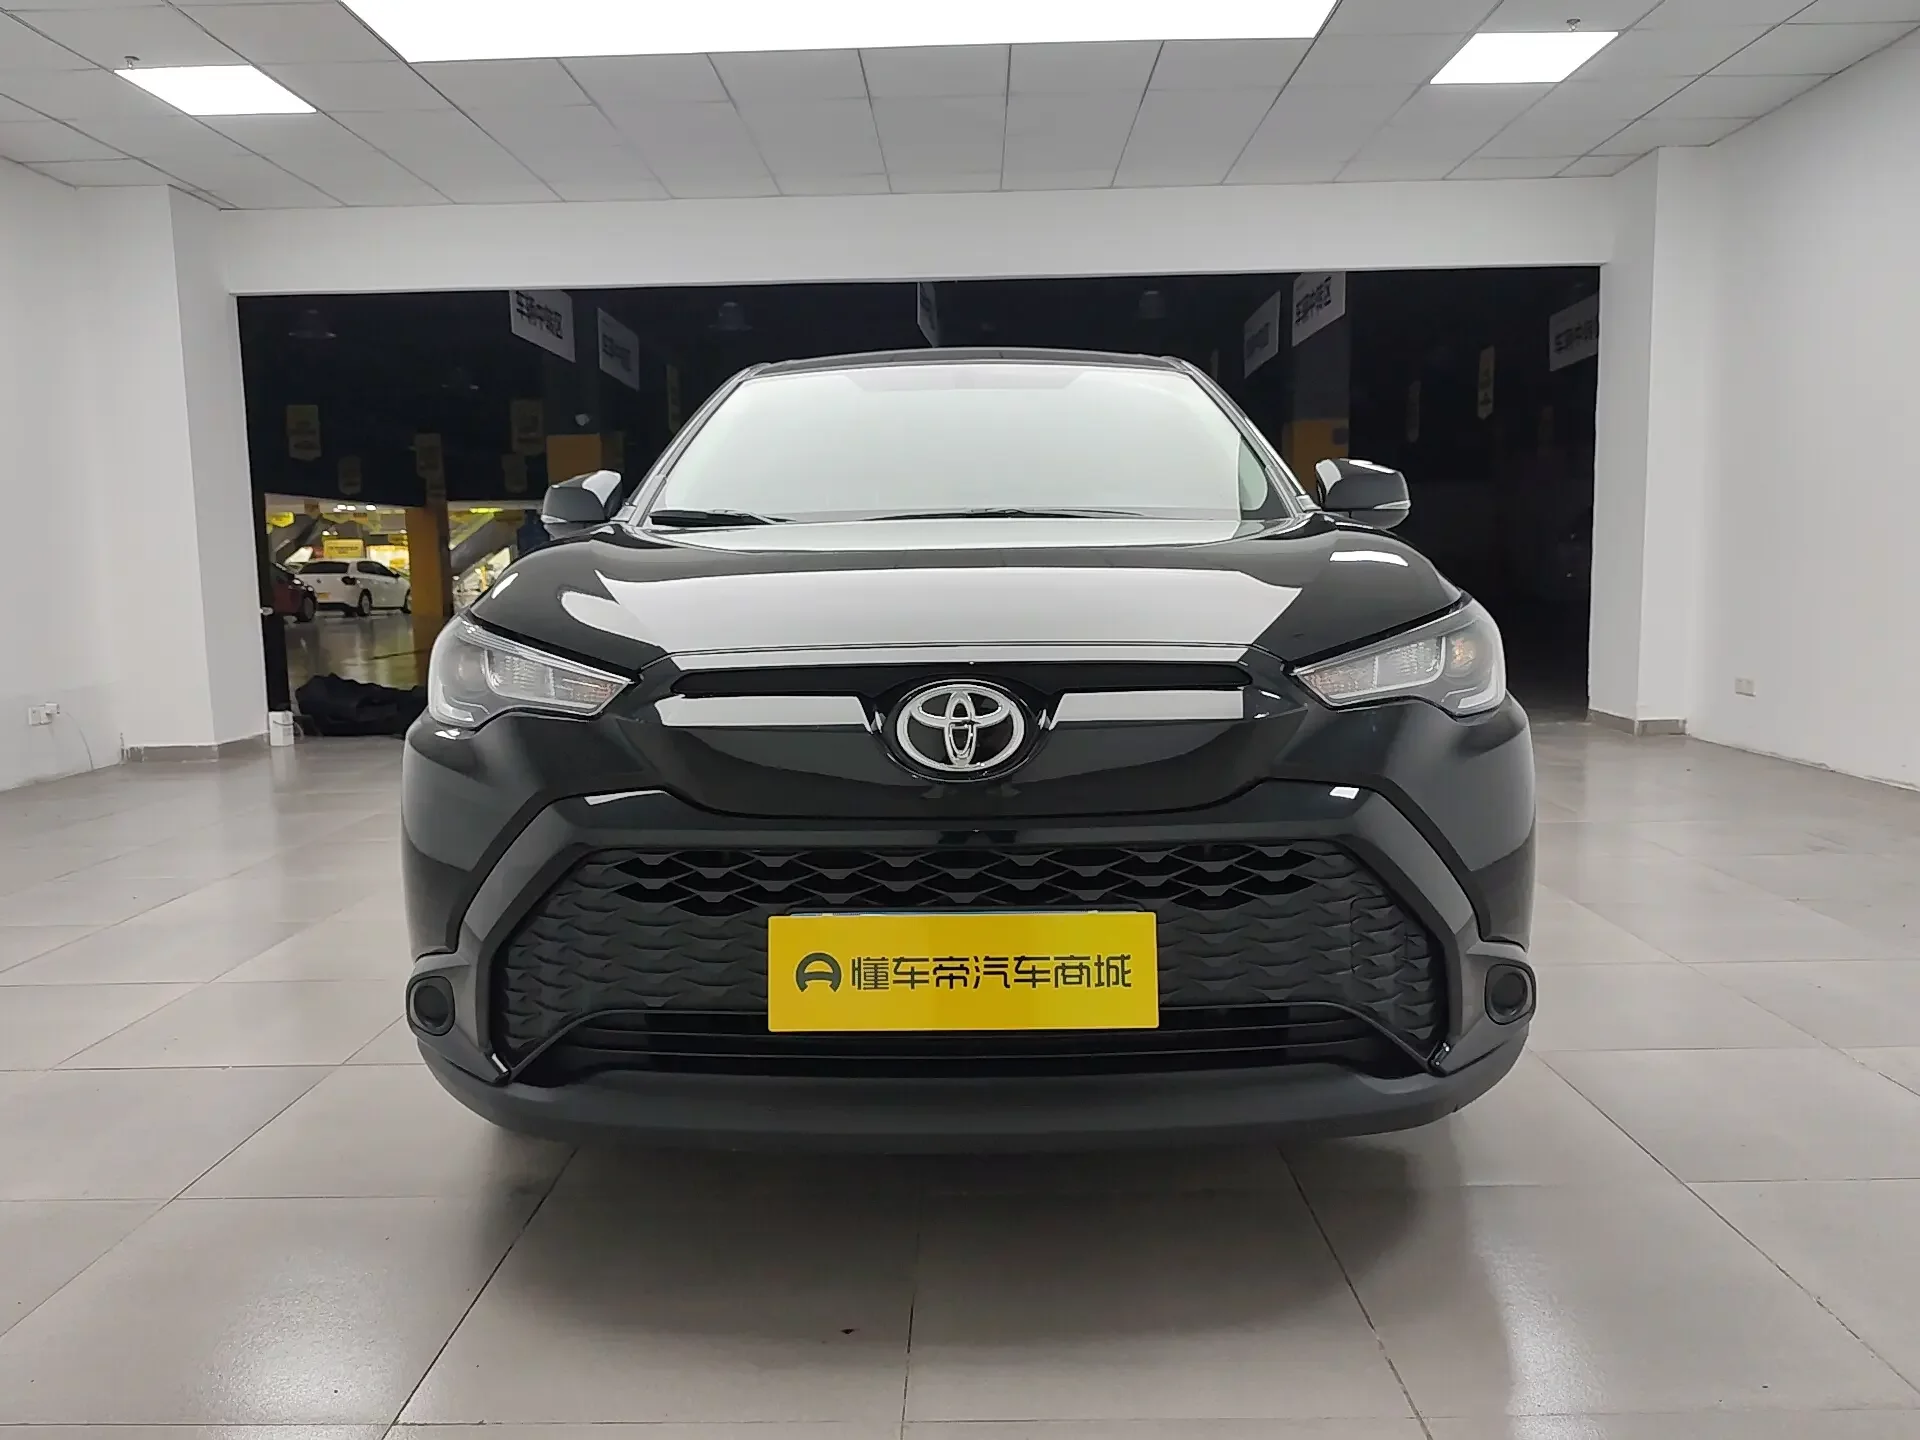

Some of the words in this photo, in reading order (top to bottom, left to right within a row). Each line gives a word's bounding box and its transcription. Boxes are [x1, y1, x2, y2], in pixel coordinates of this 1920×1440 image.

[851, 954, 1132, 991] 懂车帝汽车商城
